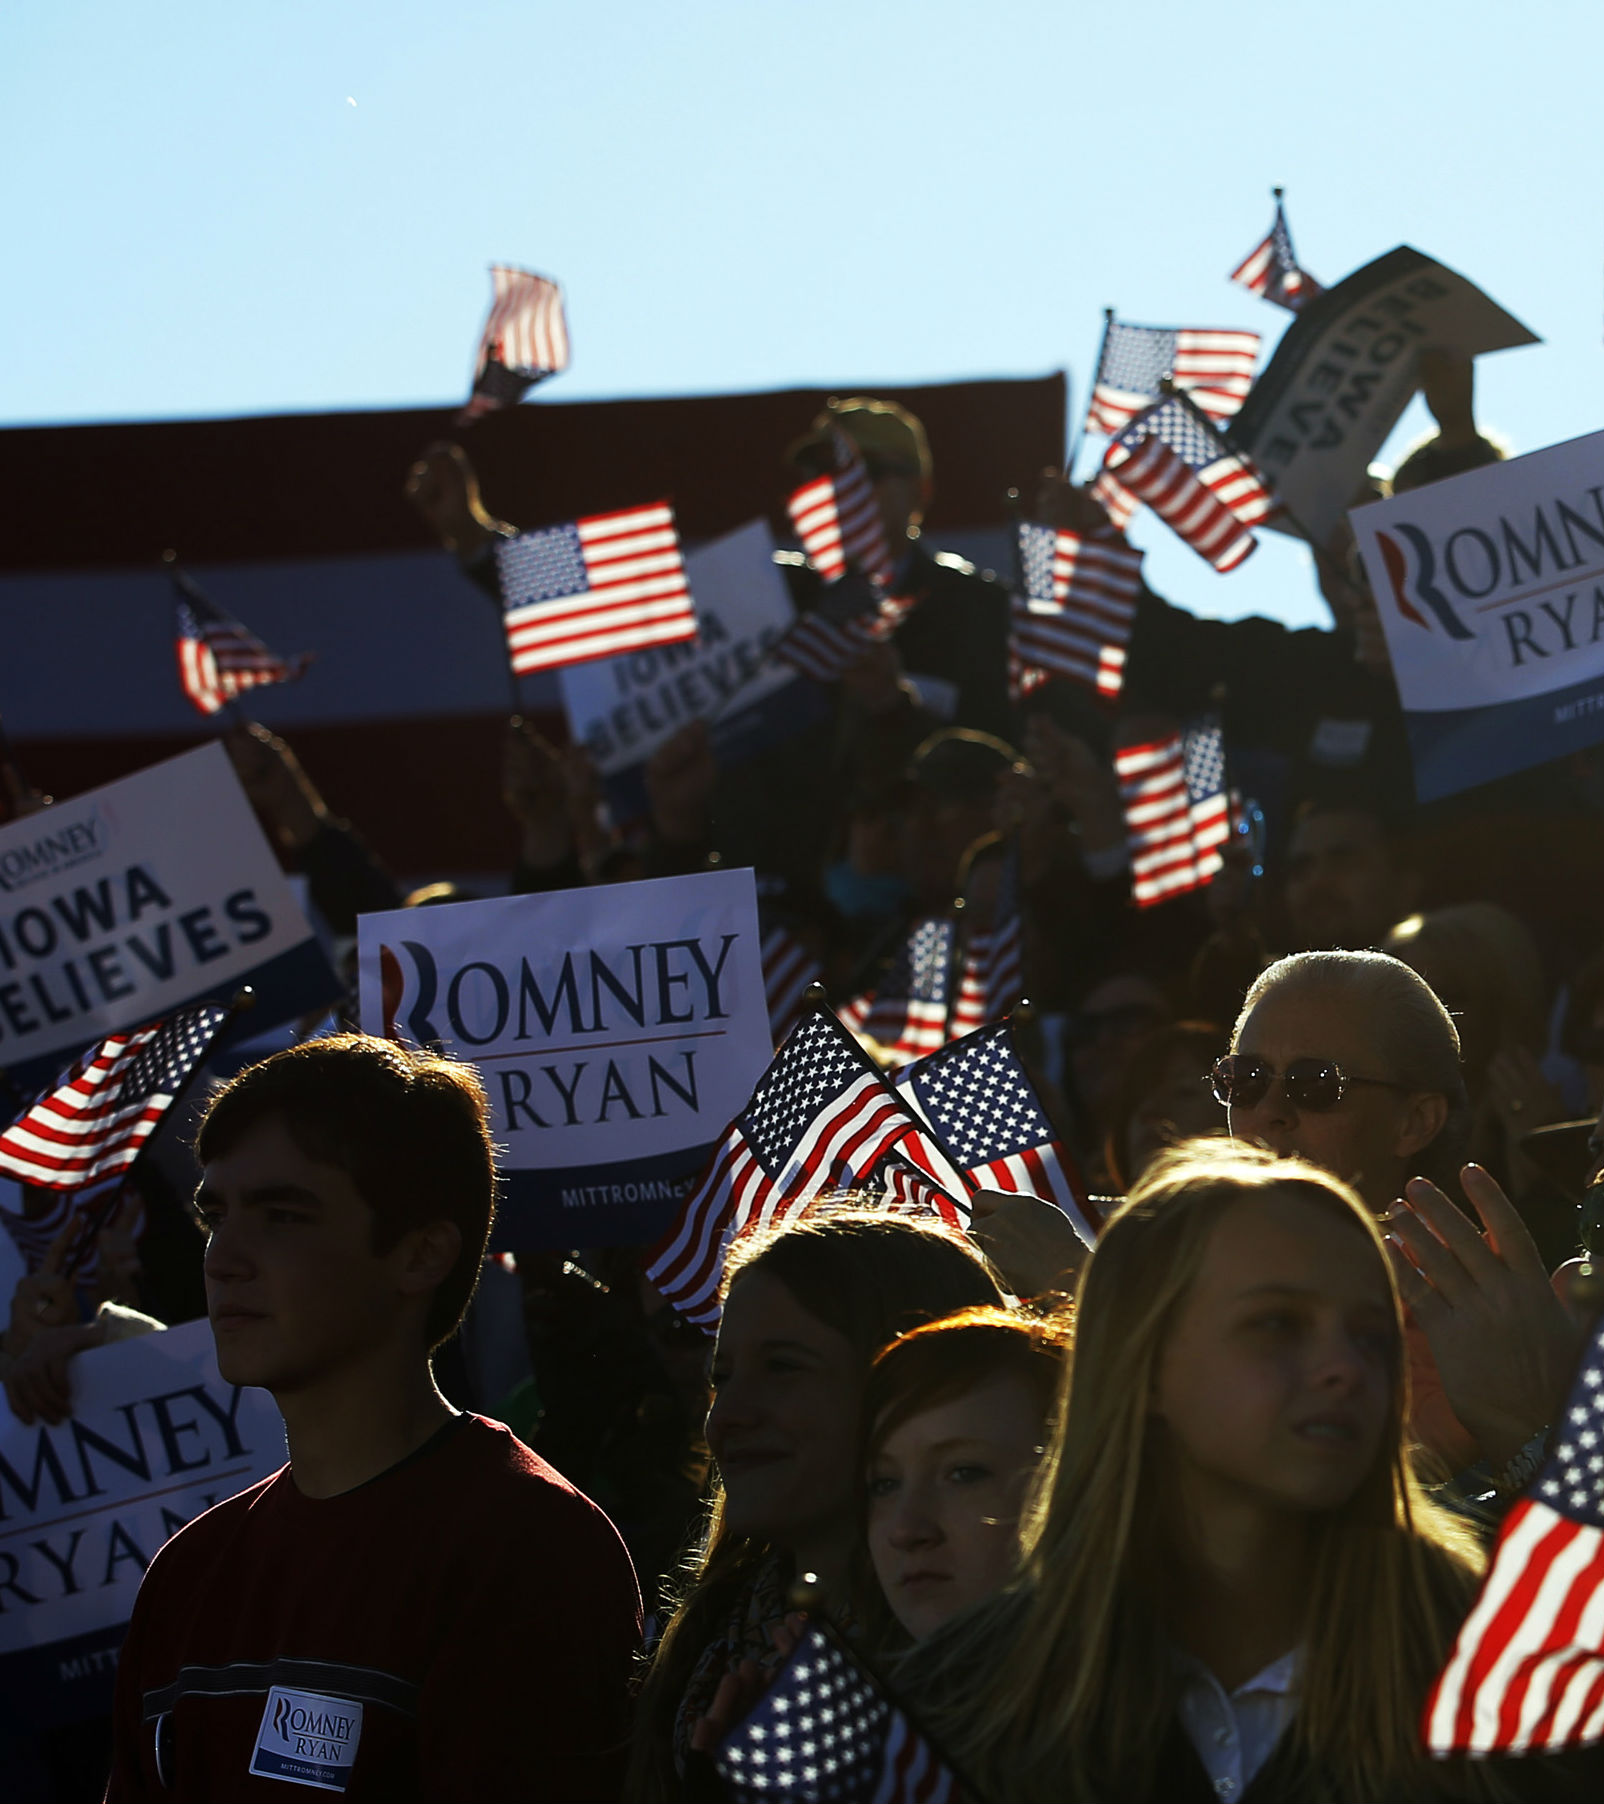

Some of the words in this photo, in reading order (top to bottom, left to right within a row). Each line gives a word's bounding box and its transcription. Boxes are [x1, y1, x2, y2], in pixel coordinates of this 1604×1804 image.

[1258, 277, 1450, 488] BELIEVE
[0, 818, 97, 893] OMNEY
[0, 888, 273, 1040] ELIEVES
[379, 934, 740, 1057] ROMNEY
[494, 1051, 700, 1132] RYAN
[0, 1495, 222, 1615] RYA
[273, 1698, 355, 1742] ROMNEY
[296, 1737, 341, 1761] RYAN
